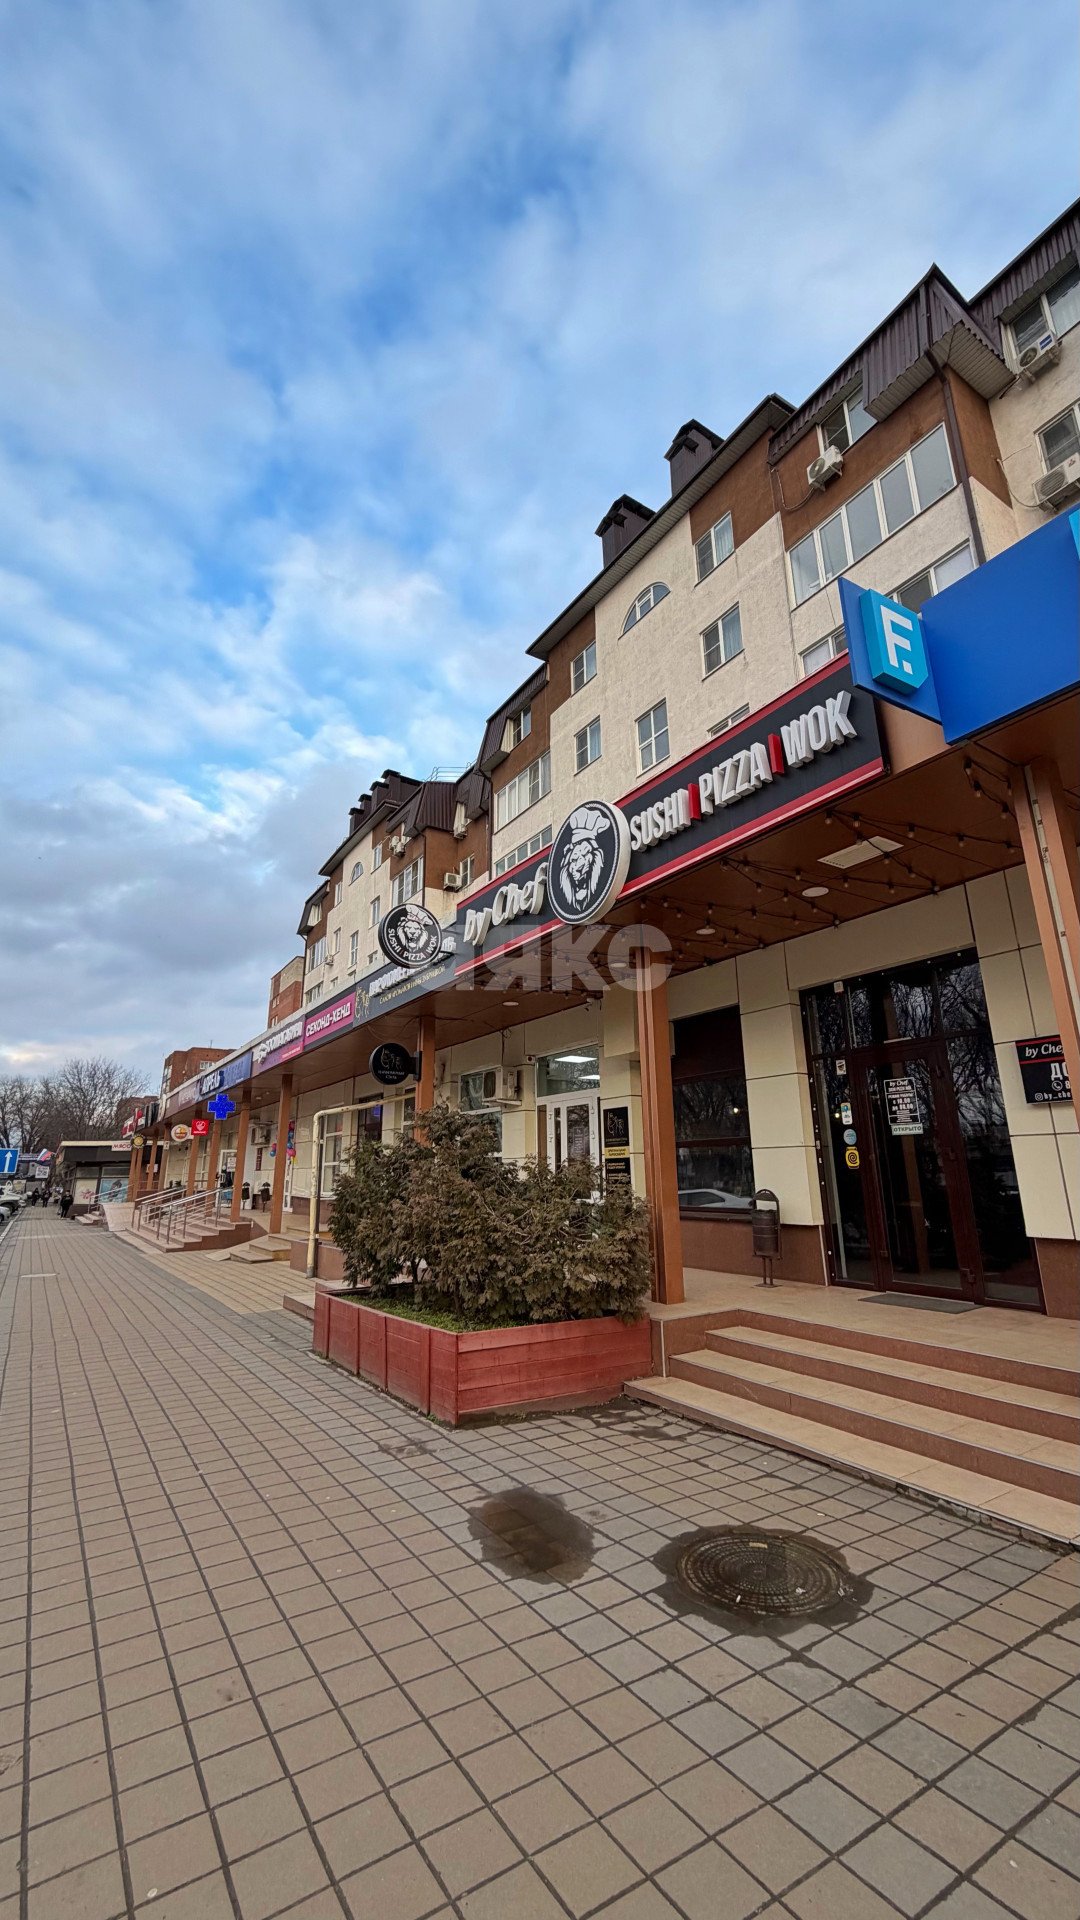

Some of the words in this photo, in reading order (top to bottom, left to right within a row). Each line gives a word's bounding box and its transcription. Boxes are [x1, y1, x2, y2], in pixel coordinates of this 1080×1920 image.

[630, 788, 691, 852] SUSHI
[699, 742, 773, 815] PIZZA
[780, 690, 857, 768] WOK
[463, 907, 493, 946] by
[492, 862, 548, 927] Chef
[388, 928, 402, 953] SUSHI
[403, 951, 426, 961] PIZZA
[426, 935, 437, 954] WOK
[305, 1002, 351, 1037] СЕКОНД-ХЕНД
[1025, 1047, 1038, 1058] by
[1041, 1044, 1064, 1054] Che
